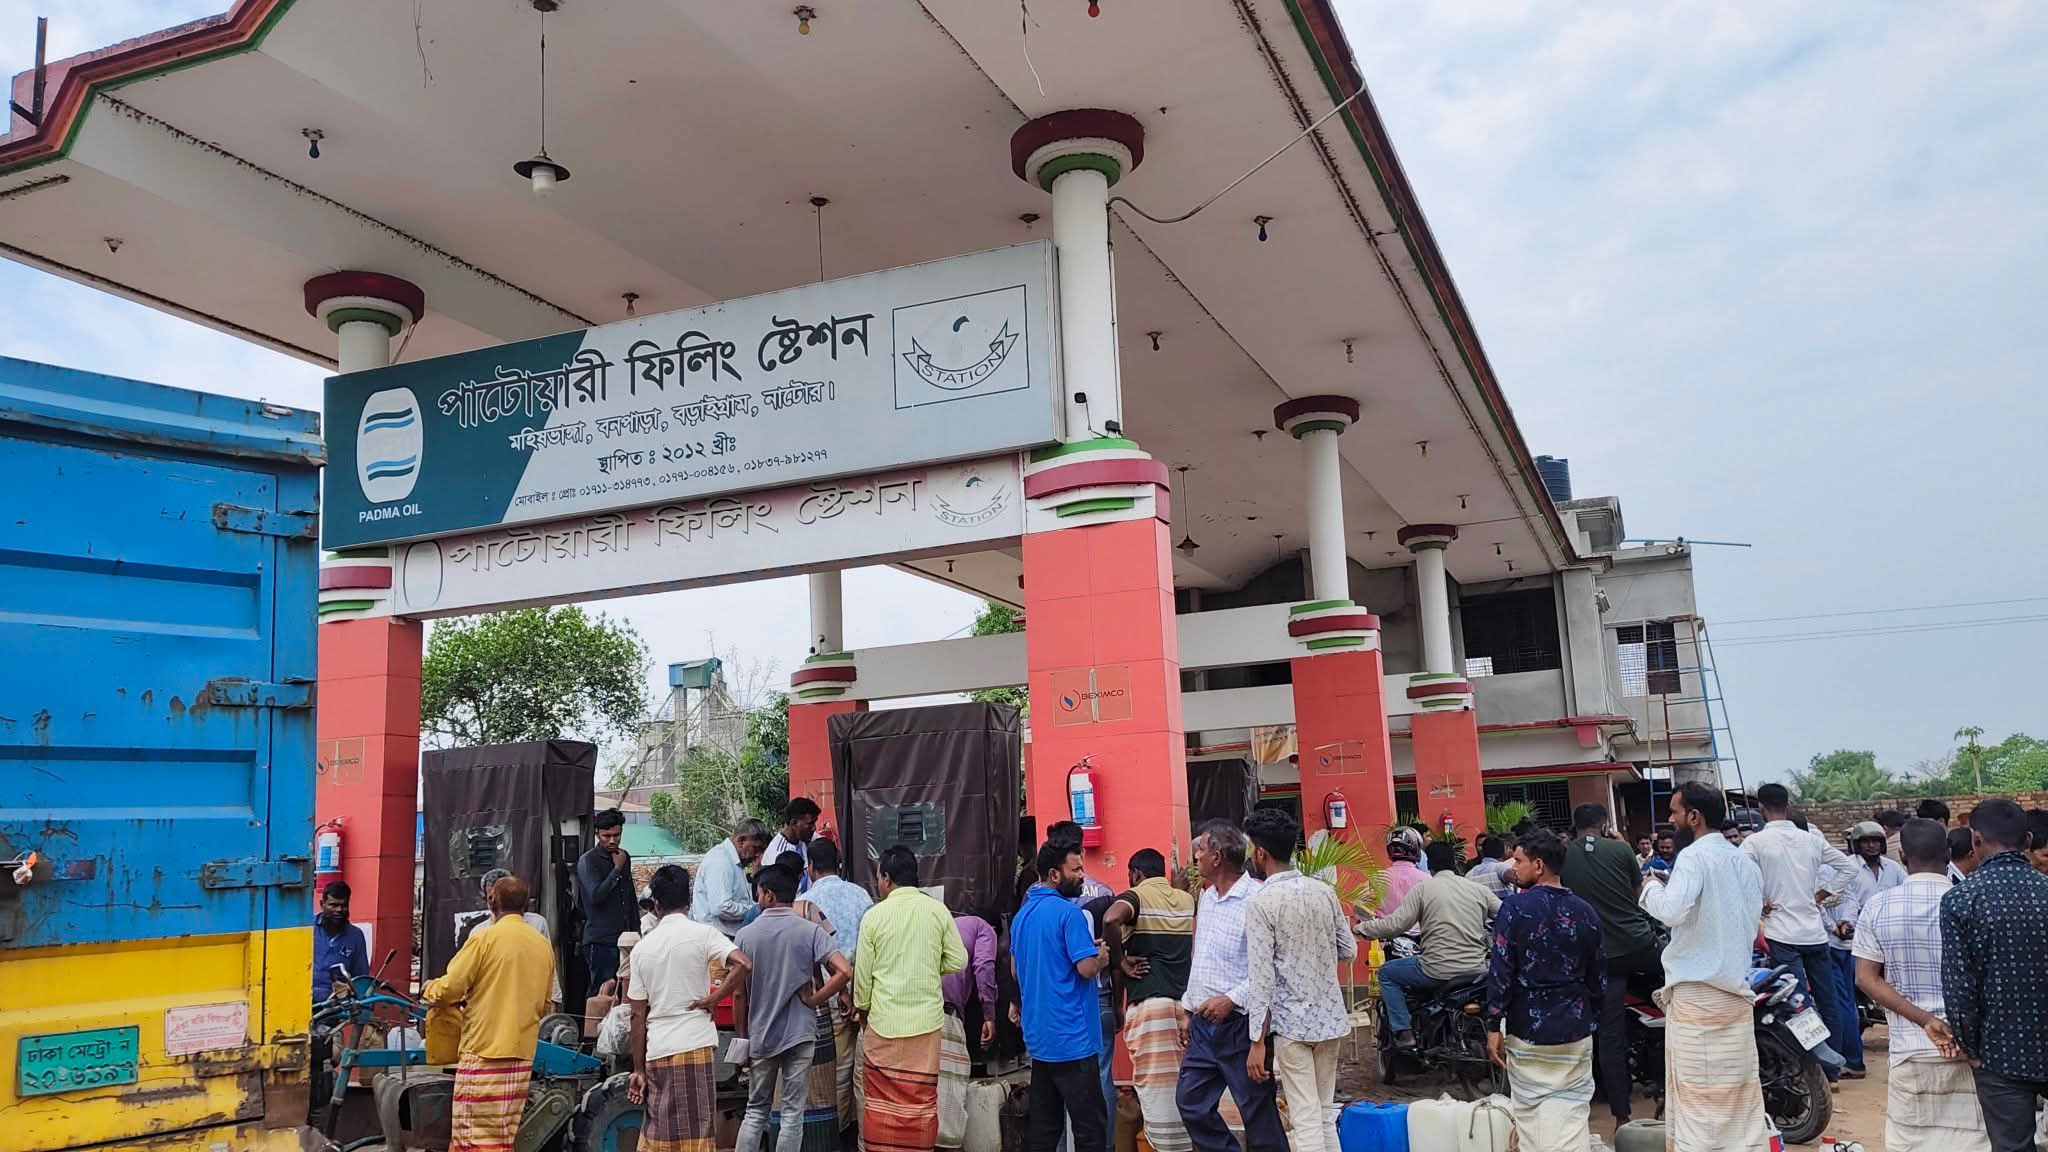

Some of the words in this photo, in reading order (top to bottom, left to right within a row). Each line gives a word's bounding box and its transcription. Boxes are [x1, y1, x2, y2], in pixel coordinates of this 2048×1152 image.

[921, 352, 1001, 384] STATION
[438, 349, 615, 428] পাটোয়ারী
[624, 330, 742, 397] ফিলিং
[596, 407, 669, 439] বনপাড়া,
[598, 449, 644, 476] স্থাপিত
[662, 441, 707, 463] ২০১২
[514, 491, 549, 507] মোবাইল
[359, 506, 401, 524] PADMA
[402, 503, 423, 516] OIL
[646, 497, 780, 547] ফিলিং
[940, 503, 1003, 524] STATION
[1082, 689, 1124, 701] BEXIMCO
[1081, 884, 1099, 898] AM
[27, 1046, 64, 1063] ঢাকা
